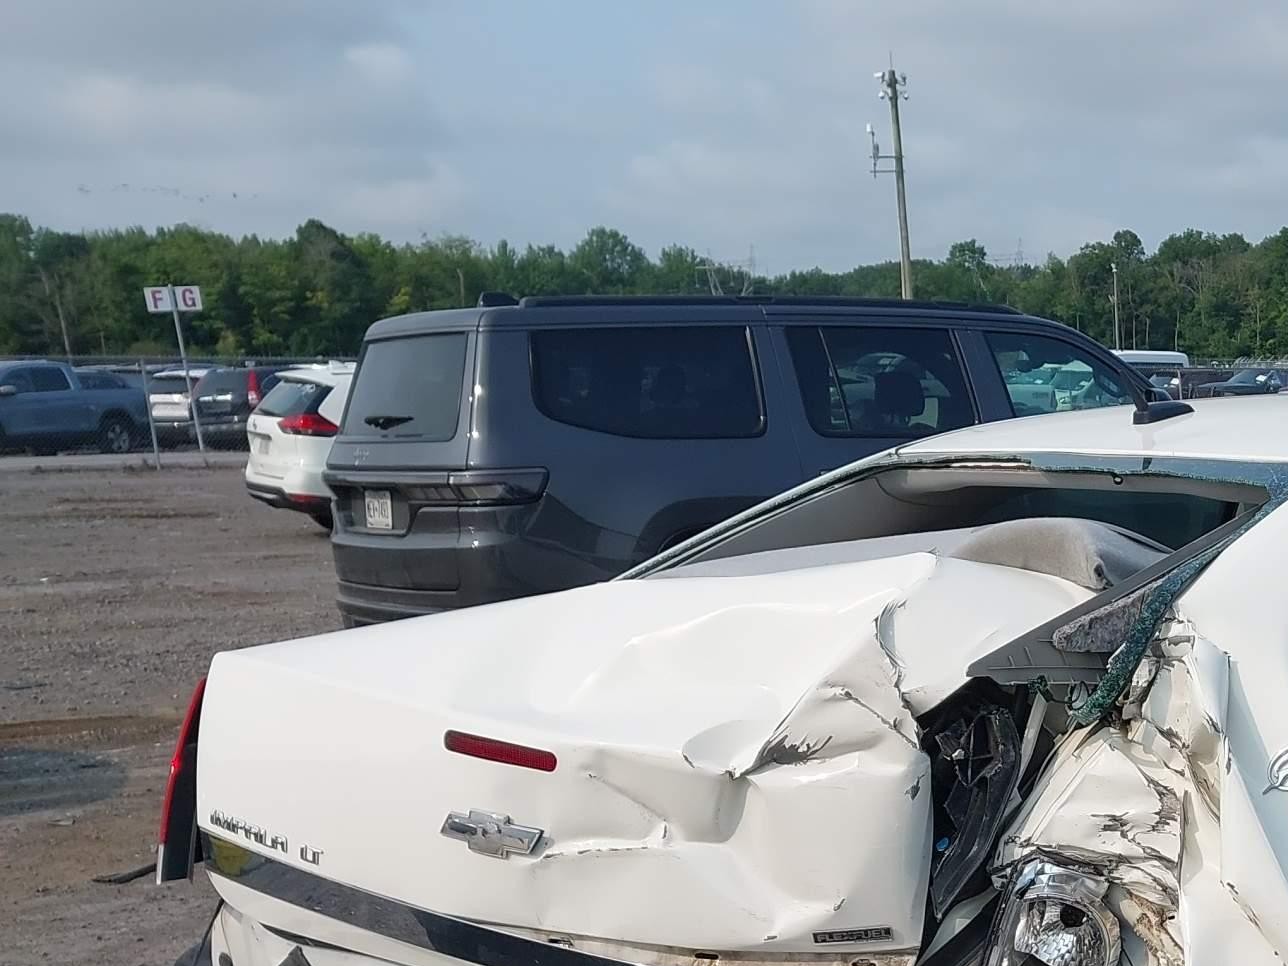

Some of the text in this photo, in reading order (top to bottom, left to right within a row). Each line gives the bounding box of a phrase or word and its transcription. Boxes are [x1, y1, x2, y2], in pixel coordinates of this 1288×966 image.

[151, 289, 163, 309] F
[182, 288, 197, 308] G
[209, 809, 323, 866] IMPALA LT
[816, 927, 893, 943] FLEXFUEL
